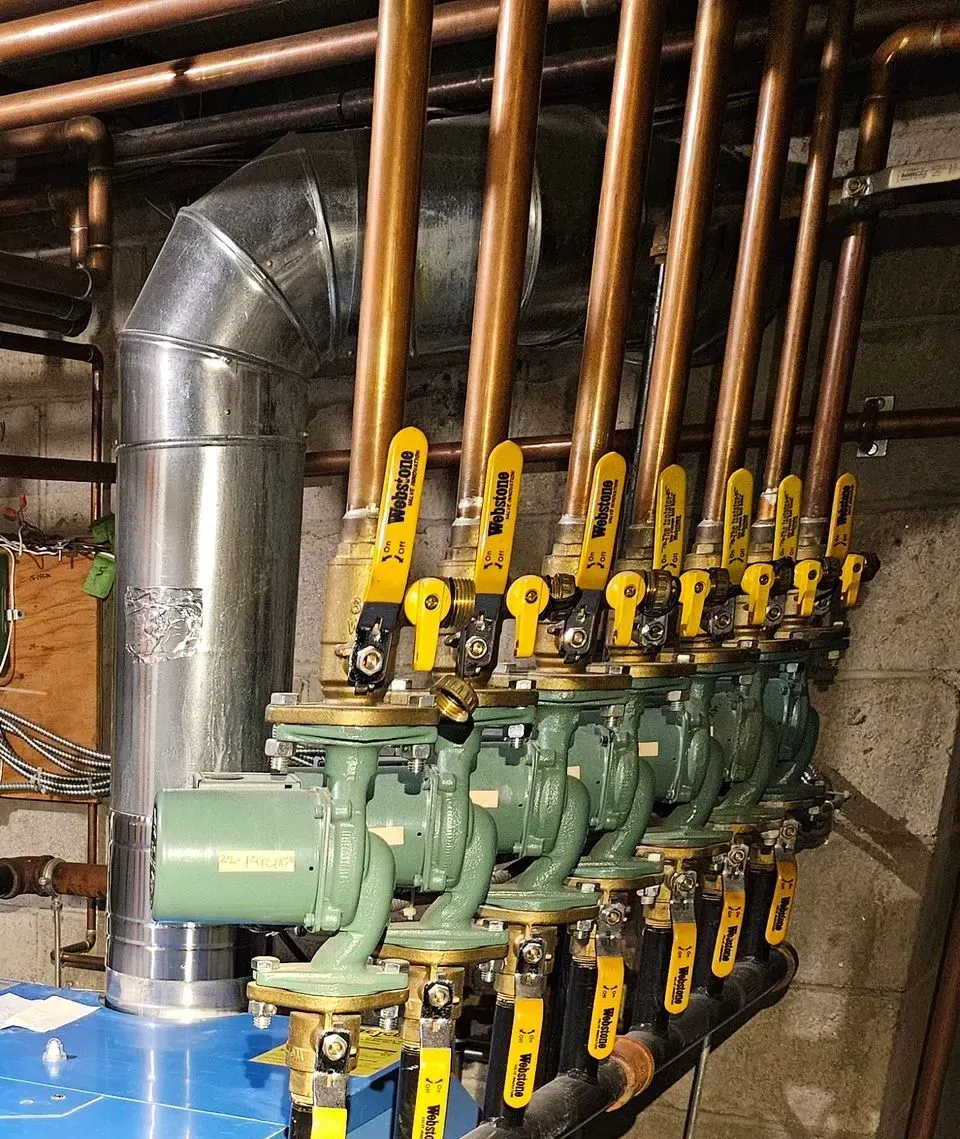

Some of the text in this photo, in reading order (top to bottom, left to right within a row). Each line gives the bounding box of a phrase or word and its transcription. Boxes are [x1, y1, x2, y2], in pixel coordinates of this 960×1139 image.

[387, 450, 415, 525] Webstone
[487, 471, 510, 537] Webstone
[836, 485, 851, 527] Webstone
[591, 480, 614, 539] Webstone
[383, 541, 391, 553] On
[398, 541, 406, 555] Off
[485, 550, 492, 562] On
[721, 925, 738, 962] Webstone
[674, 965, 690, 1005] Webstone
[597, 1007, 615, 1050] Webstone
[514, 1053, 532, 1098] Webstone
